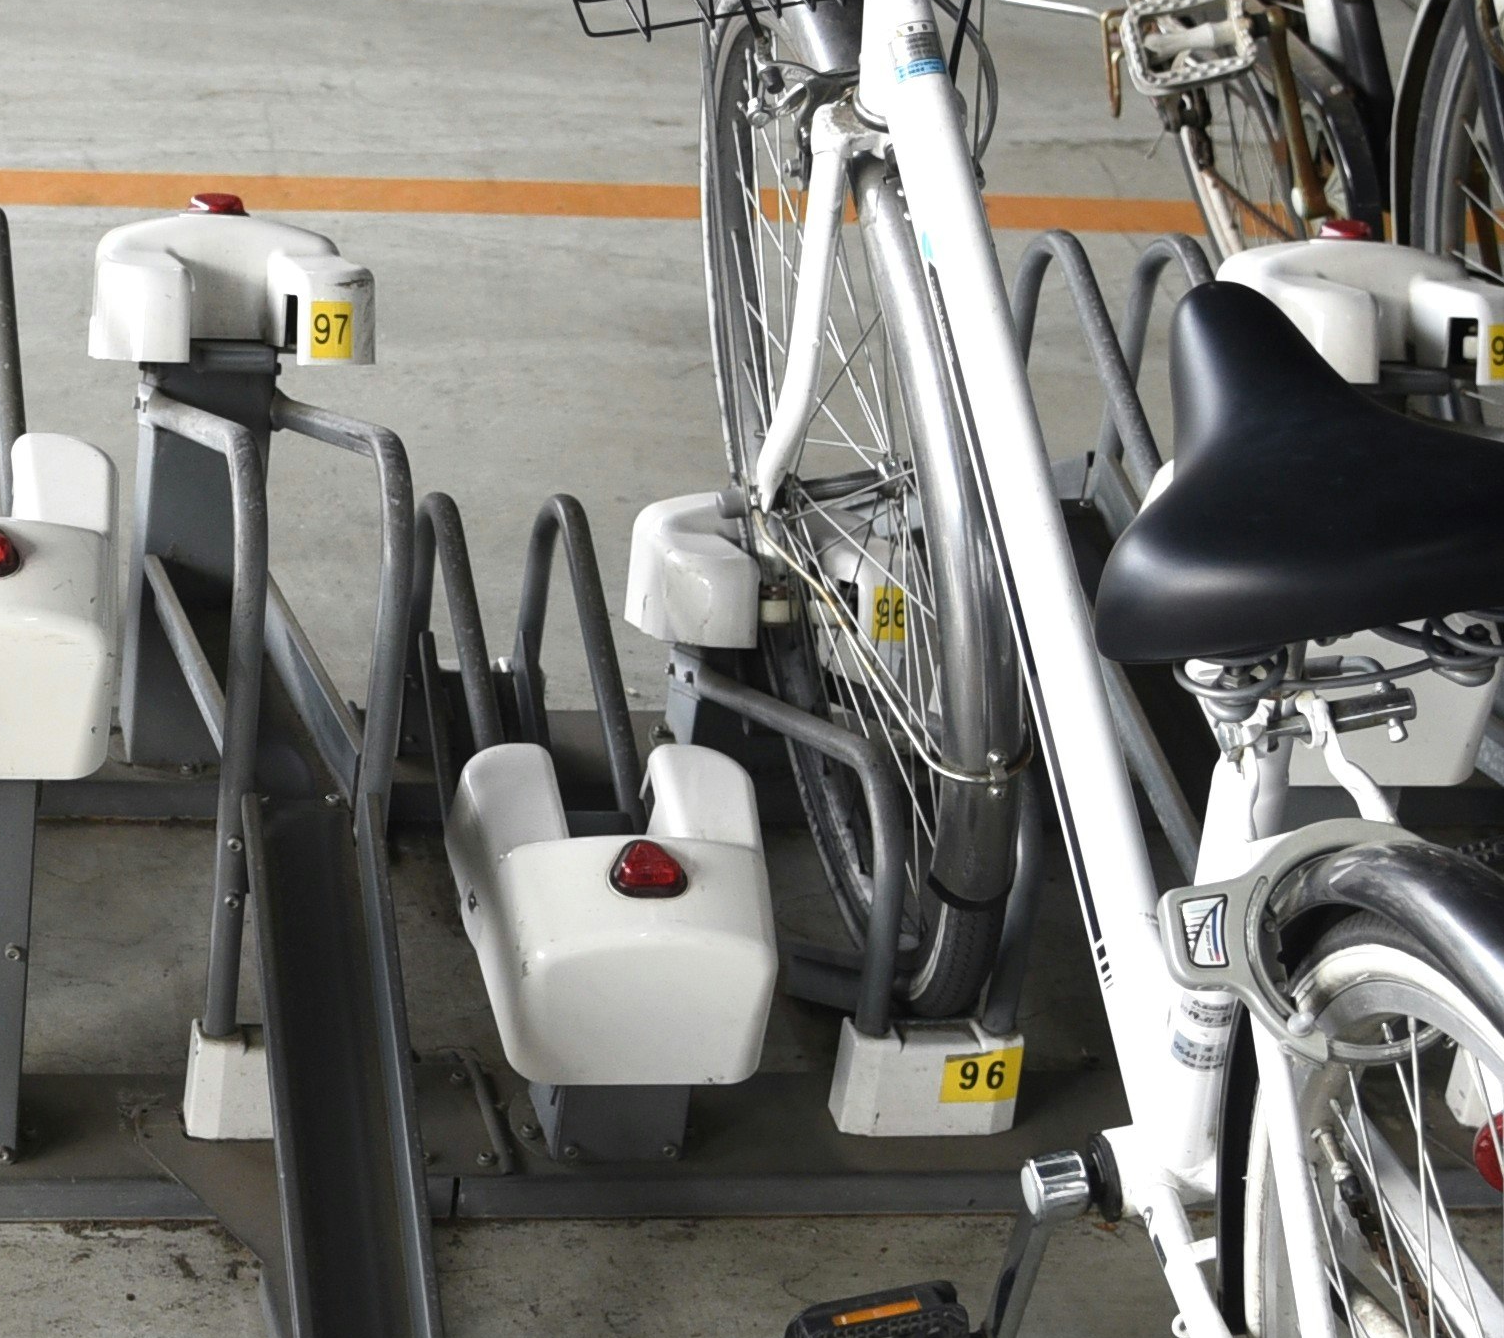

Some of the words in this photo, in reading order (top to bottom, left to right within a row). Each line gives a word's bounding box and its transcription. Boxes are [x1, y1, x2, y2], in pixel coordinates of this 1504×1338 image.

[313, 313, 349, 345] 97
[876, 597, 906, 628] 96
[959, 1060, 1006, 1090] 96
